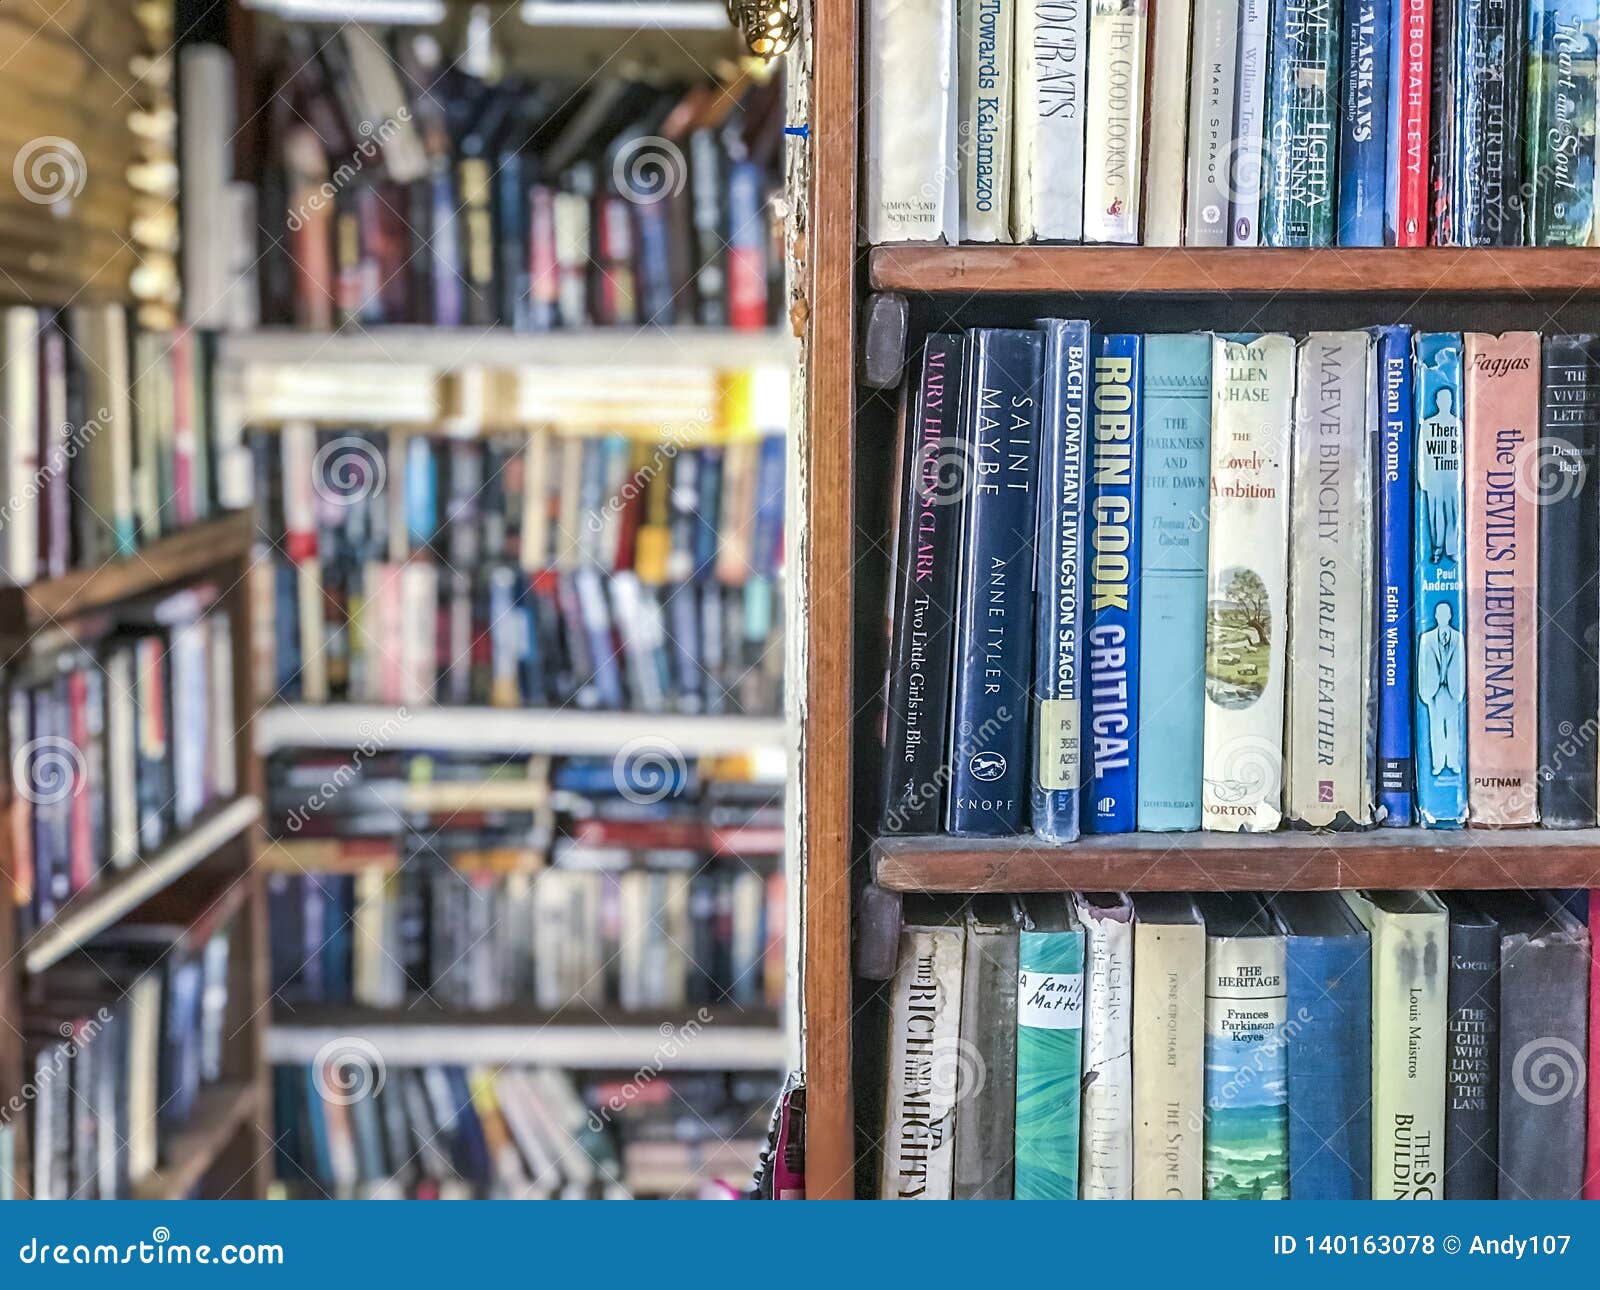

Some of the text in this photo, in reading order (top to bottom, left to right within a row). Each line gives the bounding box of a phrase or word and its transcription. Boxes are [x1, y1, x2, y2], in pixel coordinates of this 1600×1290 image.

[1248, 0, 1258, 22] uth
[1307, 0, 1330, 34] VE
[1034, 0, 1078, 119] OCRATS
[1347, 23, 1359, 122] Lee Davis Willoughby
[1352, 6, 1375, 143] ALASKANS
[1108, 60, 1132, 111] GOOD
[1407, 0, 1424, 174] DEBORAH LEVY
[976, 0, 1000, 212] Towards Kalamazoo
[1240, 47, 1257, 151] William Trevor
[1548, 11, 1583, 188] Heart and Soul
[1207, 63, 1222, 184] MARK SPRAGG
[1106, 118, 1131, 187] LOOKING
[1307, 122, 1331, 190] LIGHT
[1291, 134, 1309, 207] PENNY
[881, 202, 936, 210] SIMON AND
[888, 214, 936, 223] SCHUSTER
[1224, 347, 1267, 361] MARY
[1467, 353, 1531, 377] Fagyas
[1164, 418, 1188, 429] THE
[1387, 358, 1403, 482] Ethan Frome
[977, 388, 1002, 495] MAYBE
[1007, 396, 1033, 492] SAINT
[1145, 437, 1205, 448] DARKNESS
[1232, 433, 1252, 441] THE
[1426, 441, 1447, 454] Will
[916, 352, 946, 582] MARY HIGGINS CLARK
[1164, 457, 1187, 469] AND
[1433, 457, 1459, 470] Time
[1091, 357, 1132, 611] ROBIN COOK
[1145, 476, 1206, 488] THE DAWN
[1211, 475, 1276, 498] Ambition
[1058, 346, 1083, 700] BACH JONATHAN LIVINGSTON SEAGUL
[1318, 346, 1342, 766] MAEVE BINCHY SCARLET FEATHER
[1422, 579, 1463, 591] Anderso
[1484, 428, 1525, 738] the DEVIL'S LIEUTENANT
[985, 556, 1008, 694] ANNE TYLER
[1386, 586, 1398, 686] Edith Wharton
[905, 595, 930, 762] Two Little Girls in Blue
[1089, 624, 1130, 779] CRITICAL
[1060, 720, 1071, 730] PS
[1059, 770, 1071, 780] J6
[1474, 778, 1521, 787] PUTNAM
[957, 799, 1013, 811] KNOPF
[1144, 800, 1195, 808] DOUBLEDAY
[1204, 805, 1257, 816] NORTON
[917, 956, 932, 982] THE
[1237, 966, 1262, 977] THE
[1019, 974, 1082, 1001] A Famil
[1218, 976, 1280, 988] HERITAGE
[906, 984, 936, 1056] RICH
[1166, 970, 1178, 1068] JANE URQUHART
[1221, 1020, 1274, 1031] Parkinson
[1227, 1009, 1269, 1019] Frances
[1459, 1008, 1487, 1019] THE
[1232, 1031, 1264, 1043] Keyes
[1408, 988, 1422, 1079] Louis Maistros
[1457, 1034, 1487, 1045] GIRL
[1455, 1046, 1488, 1057] WHO
[1452, 1059, 1488, 1070] LIVES
[1449, 1072, 1488, 1083] DOWN
[1453, 1098, 1487, 1109] LANE
[1456, 1086, 1484, 1097] THE
[1167, 1102, 1180, 1127] THE
[899, 1089, 931, 1199] MIGHTY
[1414, 1130, 1431, 1168] THE
[1165, 1133, 1184, 1182] STONE
